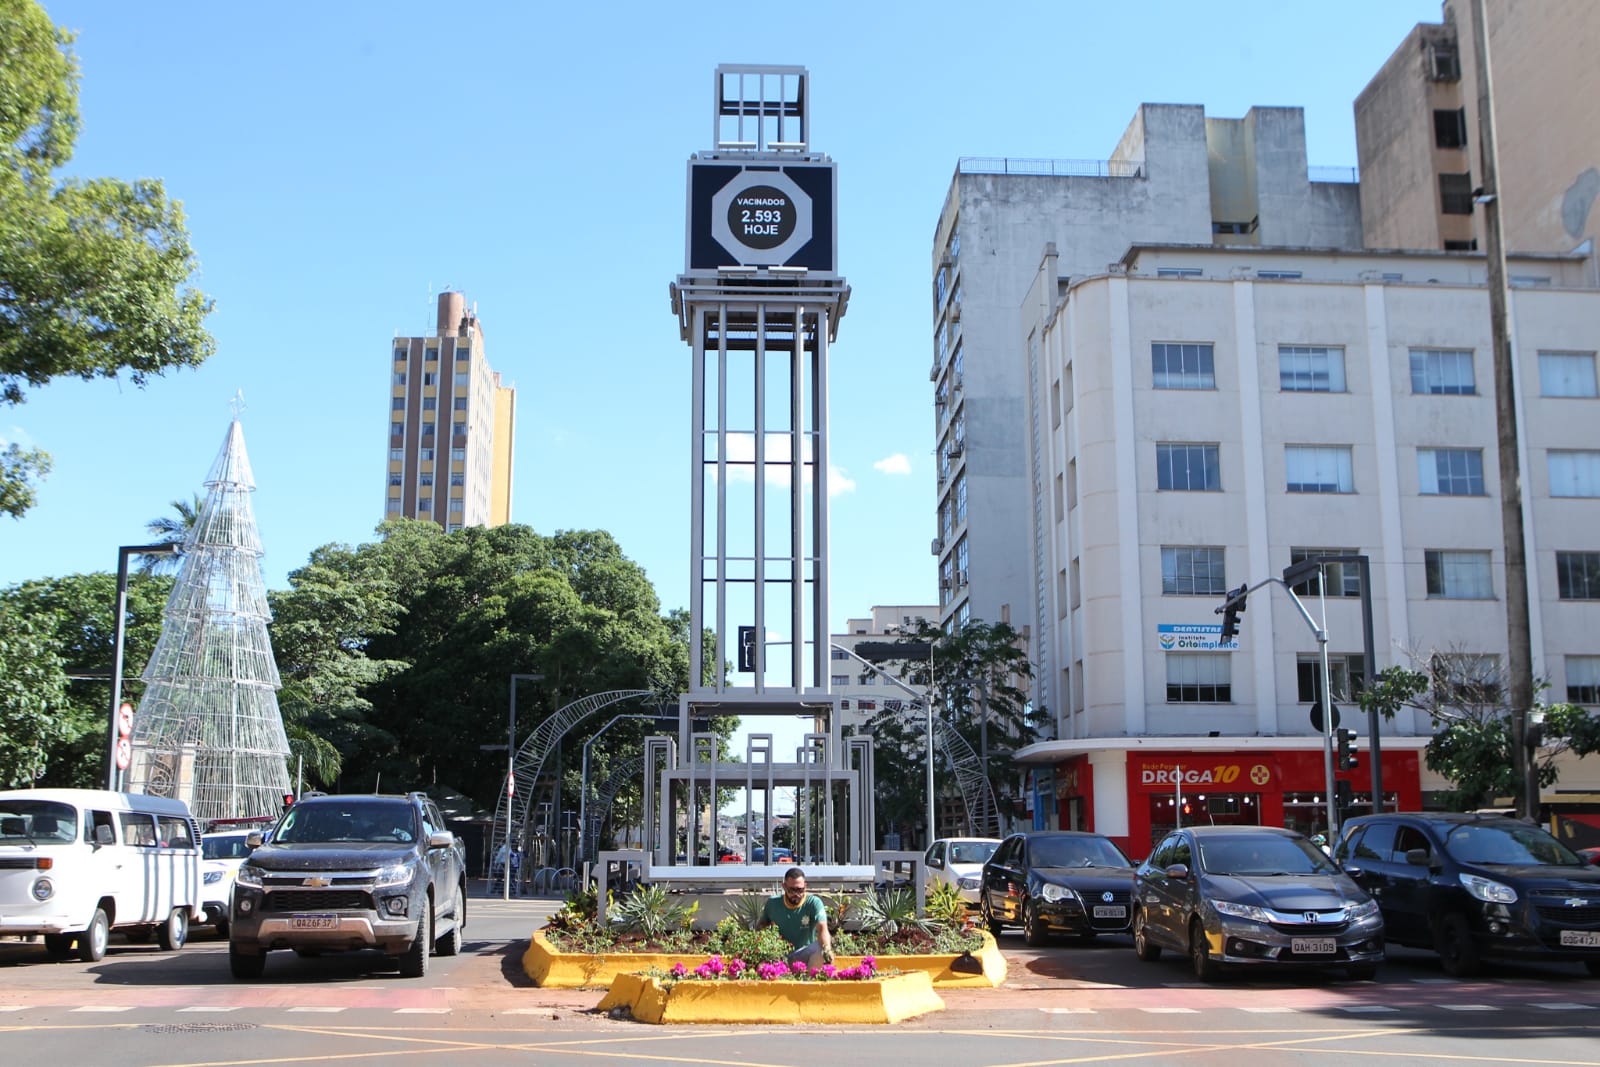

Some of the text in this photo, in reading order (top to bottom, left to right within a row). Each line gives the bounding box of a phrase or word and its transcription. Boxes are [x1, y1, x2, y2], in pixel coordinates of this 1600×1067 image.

[737, 198, 785, 206] VACINADOS
[741, 210, 781, 223] 2.593
[744, 224, 779, 235] HOJE
